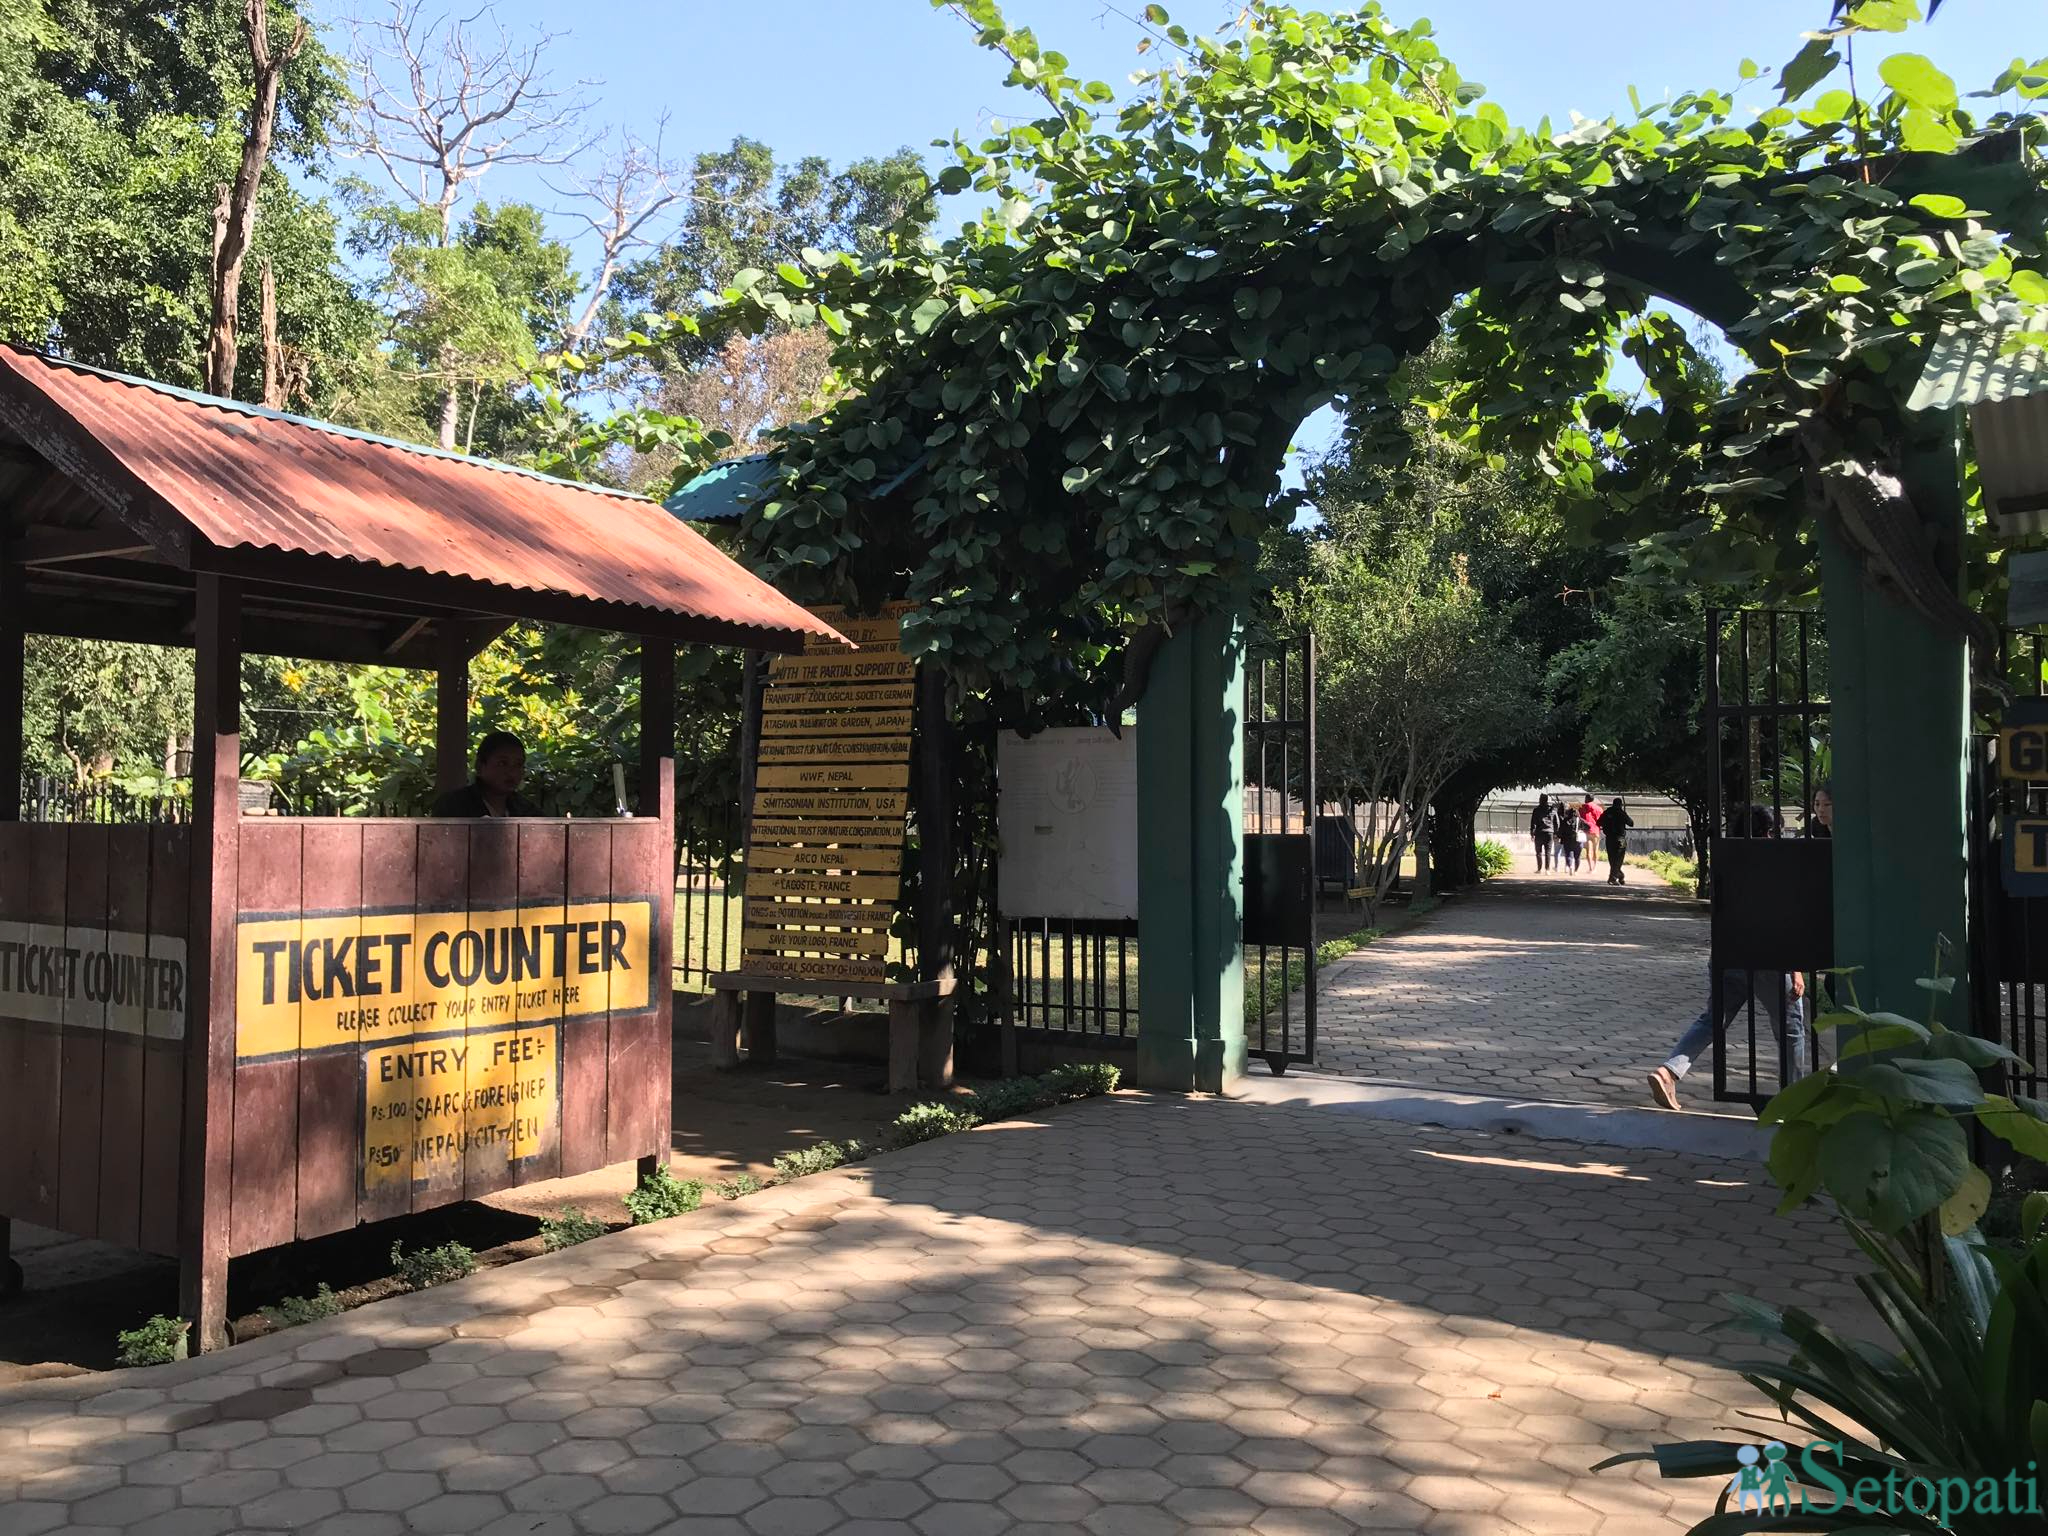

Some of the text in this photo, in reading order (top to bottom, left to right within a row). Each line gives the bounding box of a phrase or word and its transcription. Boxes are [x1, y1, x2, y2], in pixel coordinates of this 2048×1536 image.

[776, 666, 798, 681] WITH
[803, 664, 817, 679] THE
[820, 662, 851, 678] PARTIAL
[854, 662, 895, 676] SUPPORT
[765, 691, 805, 704] FRANKFURT
[808, 688, 853, 703] ZOOLOGICAL
[800, 771, 853, 783] WWF, NEPAL
[763, 798, 896, 811] SMITHSONIAN INSTITUTION, USA
[798, 826, 816, 835] TRUST
[794, 853, 846, 865] ARCO NEPAL
[819, 881, 851, 892] FRANCE
[769, 935, 786, 945] SAVE
[788, 935, 808, 946] YOUR
[829, 937, 858, 949] FRANCE
[253, 920, 631, 1005] TICKET COUNTER
[0, 941, 183, 1012] TICKET COUNTER
[337, 1007, 380, 1031] PLEASE
[388, 1001, 438, 1026] COLLECT
[445, 997, 476, 1018] YOUR
[517, 988, 547, 1009] TICKET
[380, 1046, 468, 1083] ENTRY
[415, 1091, 460, 1122] SAARC
